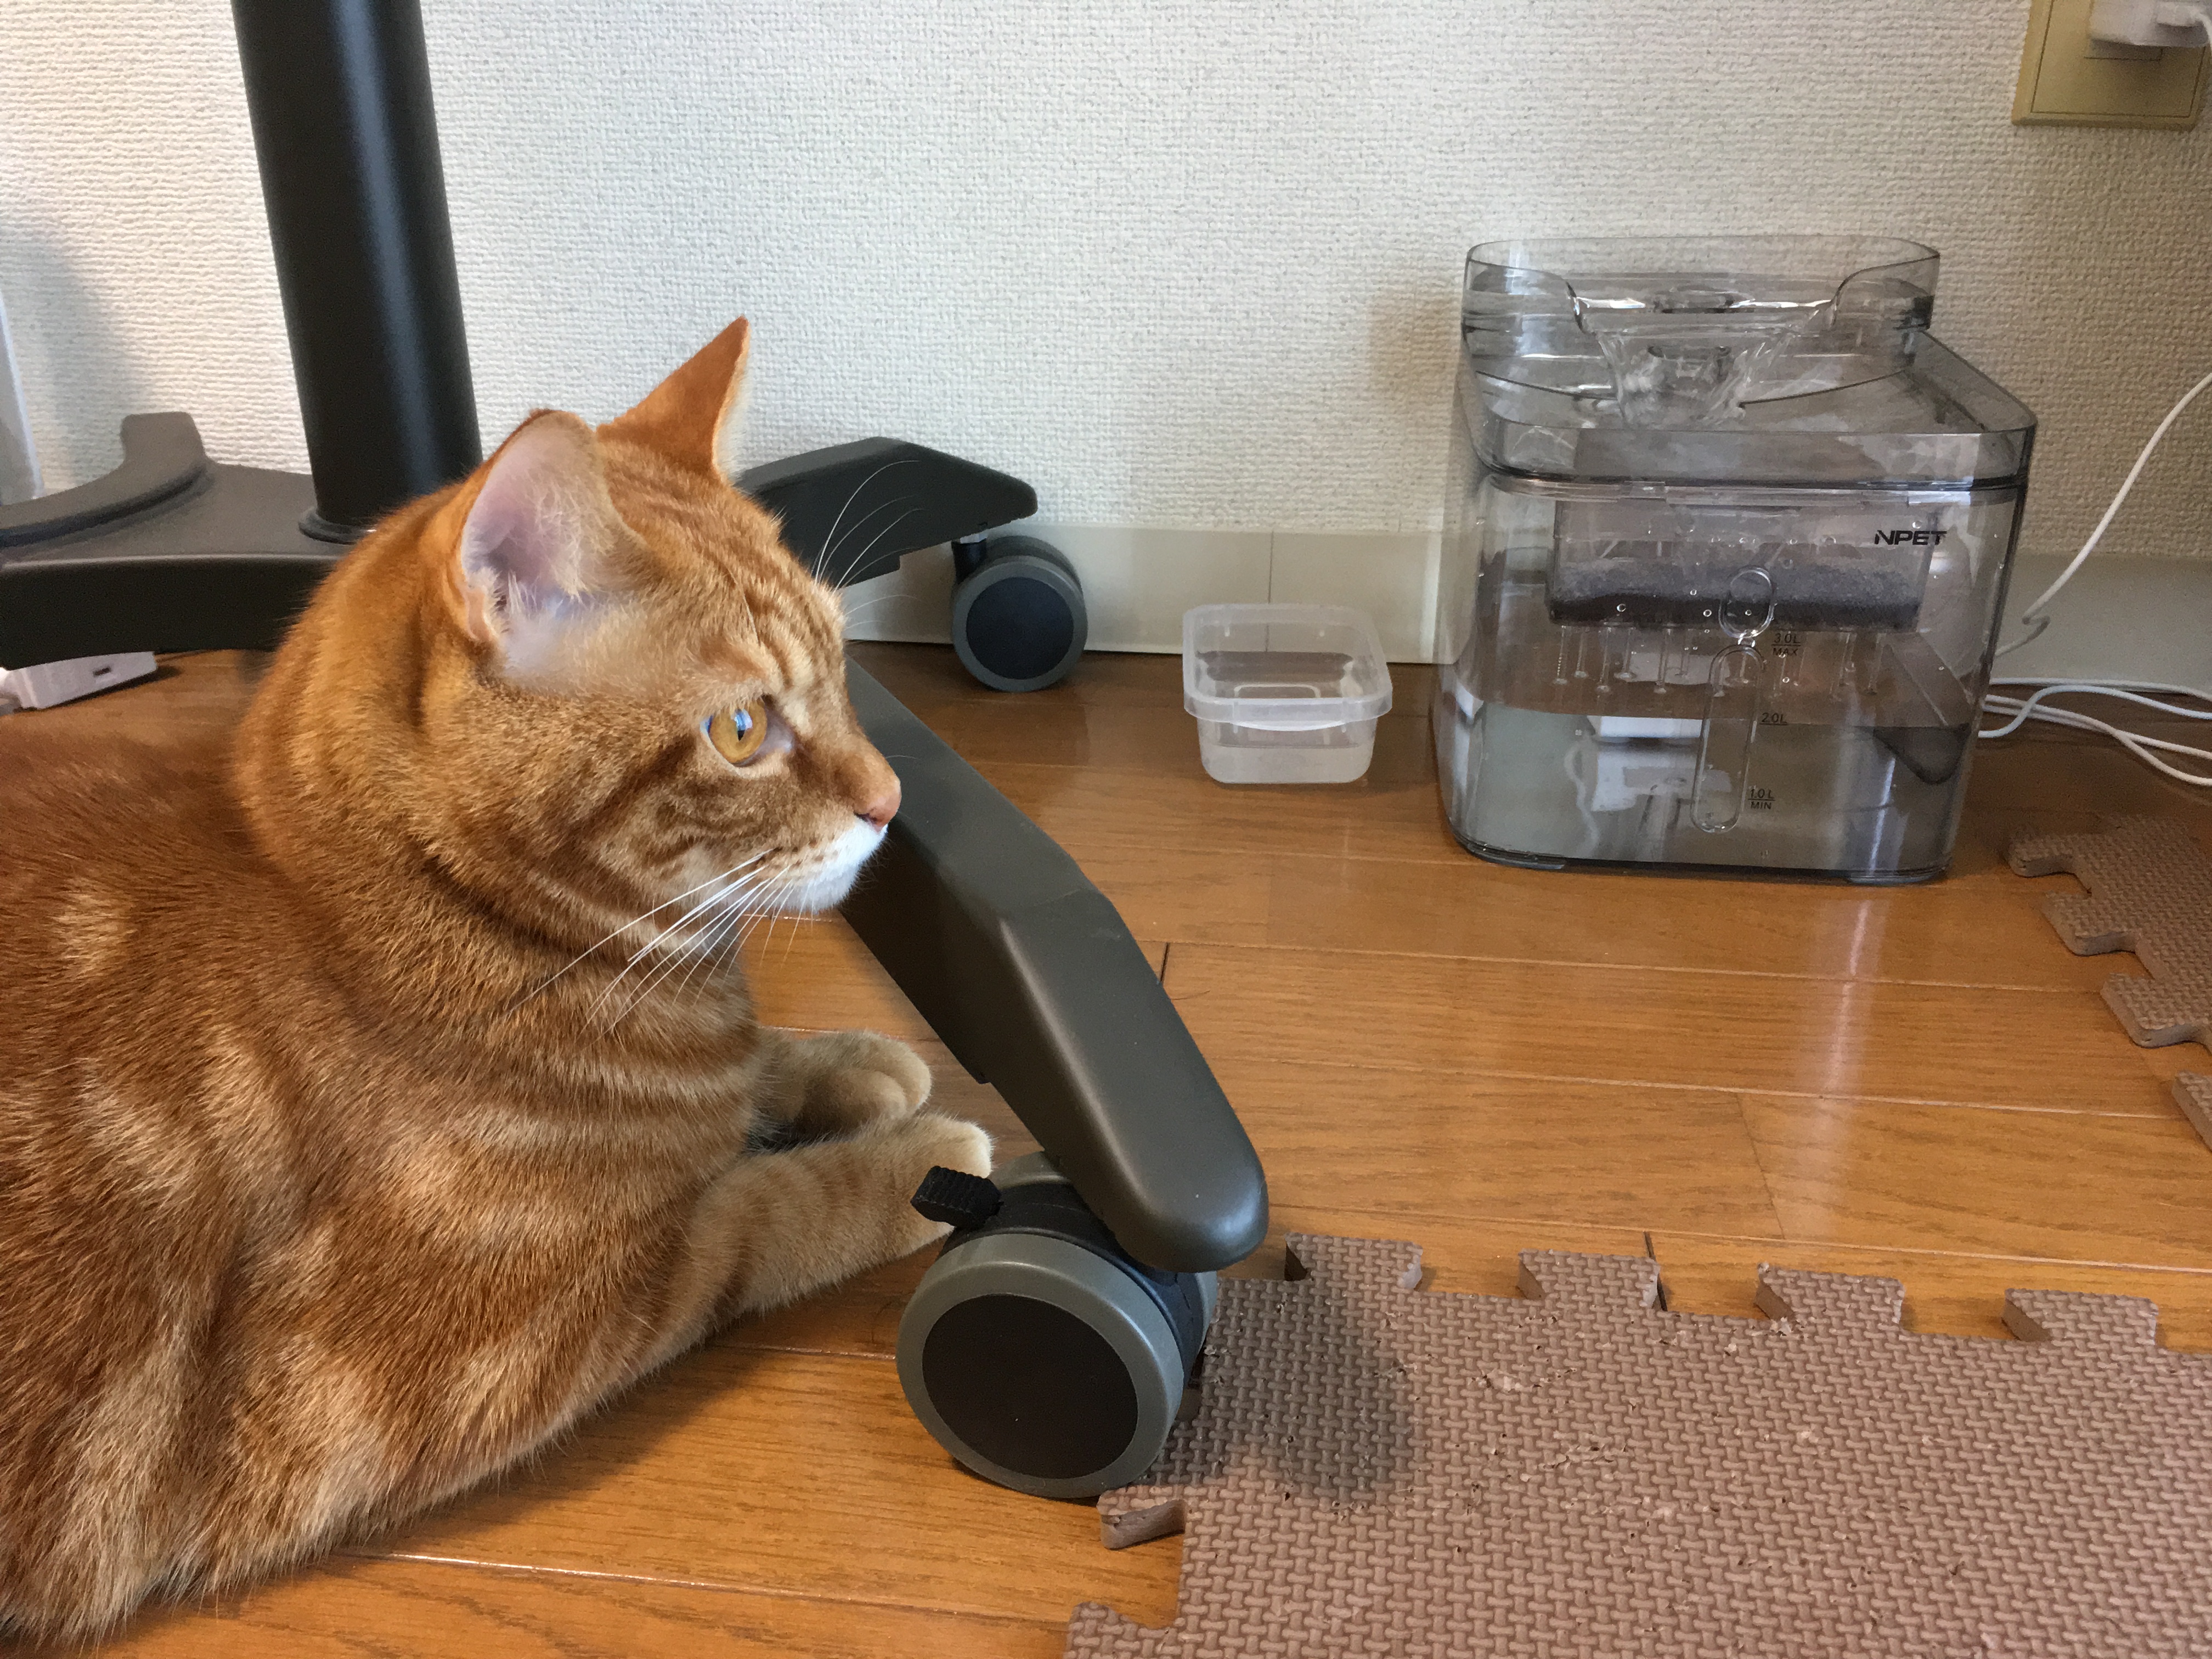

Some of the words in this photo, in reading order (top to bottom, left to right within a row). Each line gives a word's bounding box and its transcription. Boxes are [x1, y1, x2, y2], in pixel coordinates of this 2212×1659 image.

[1874, 530, 1947, 545] NPET
[1773, 647, 1798, 656] MAX
[1751, 801, 1771, 809] MIN
